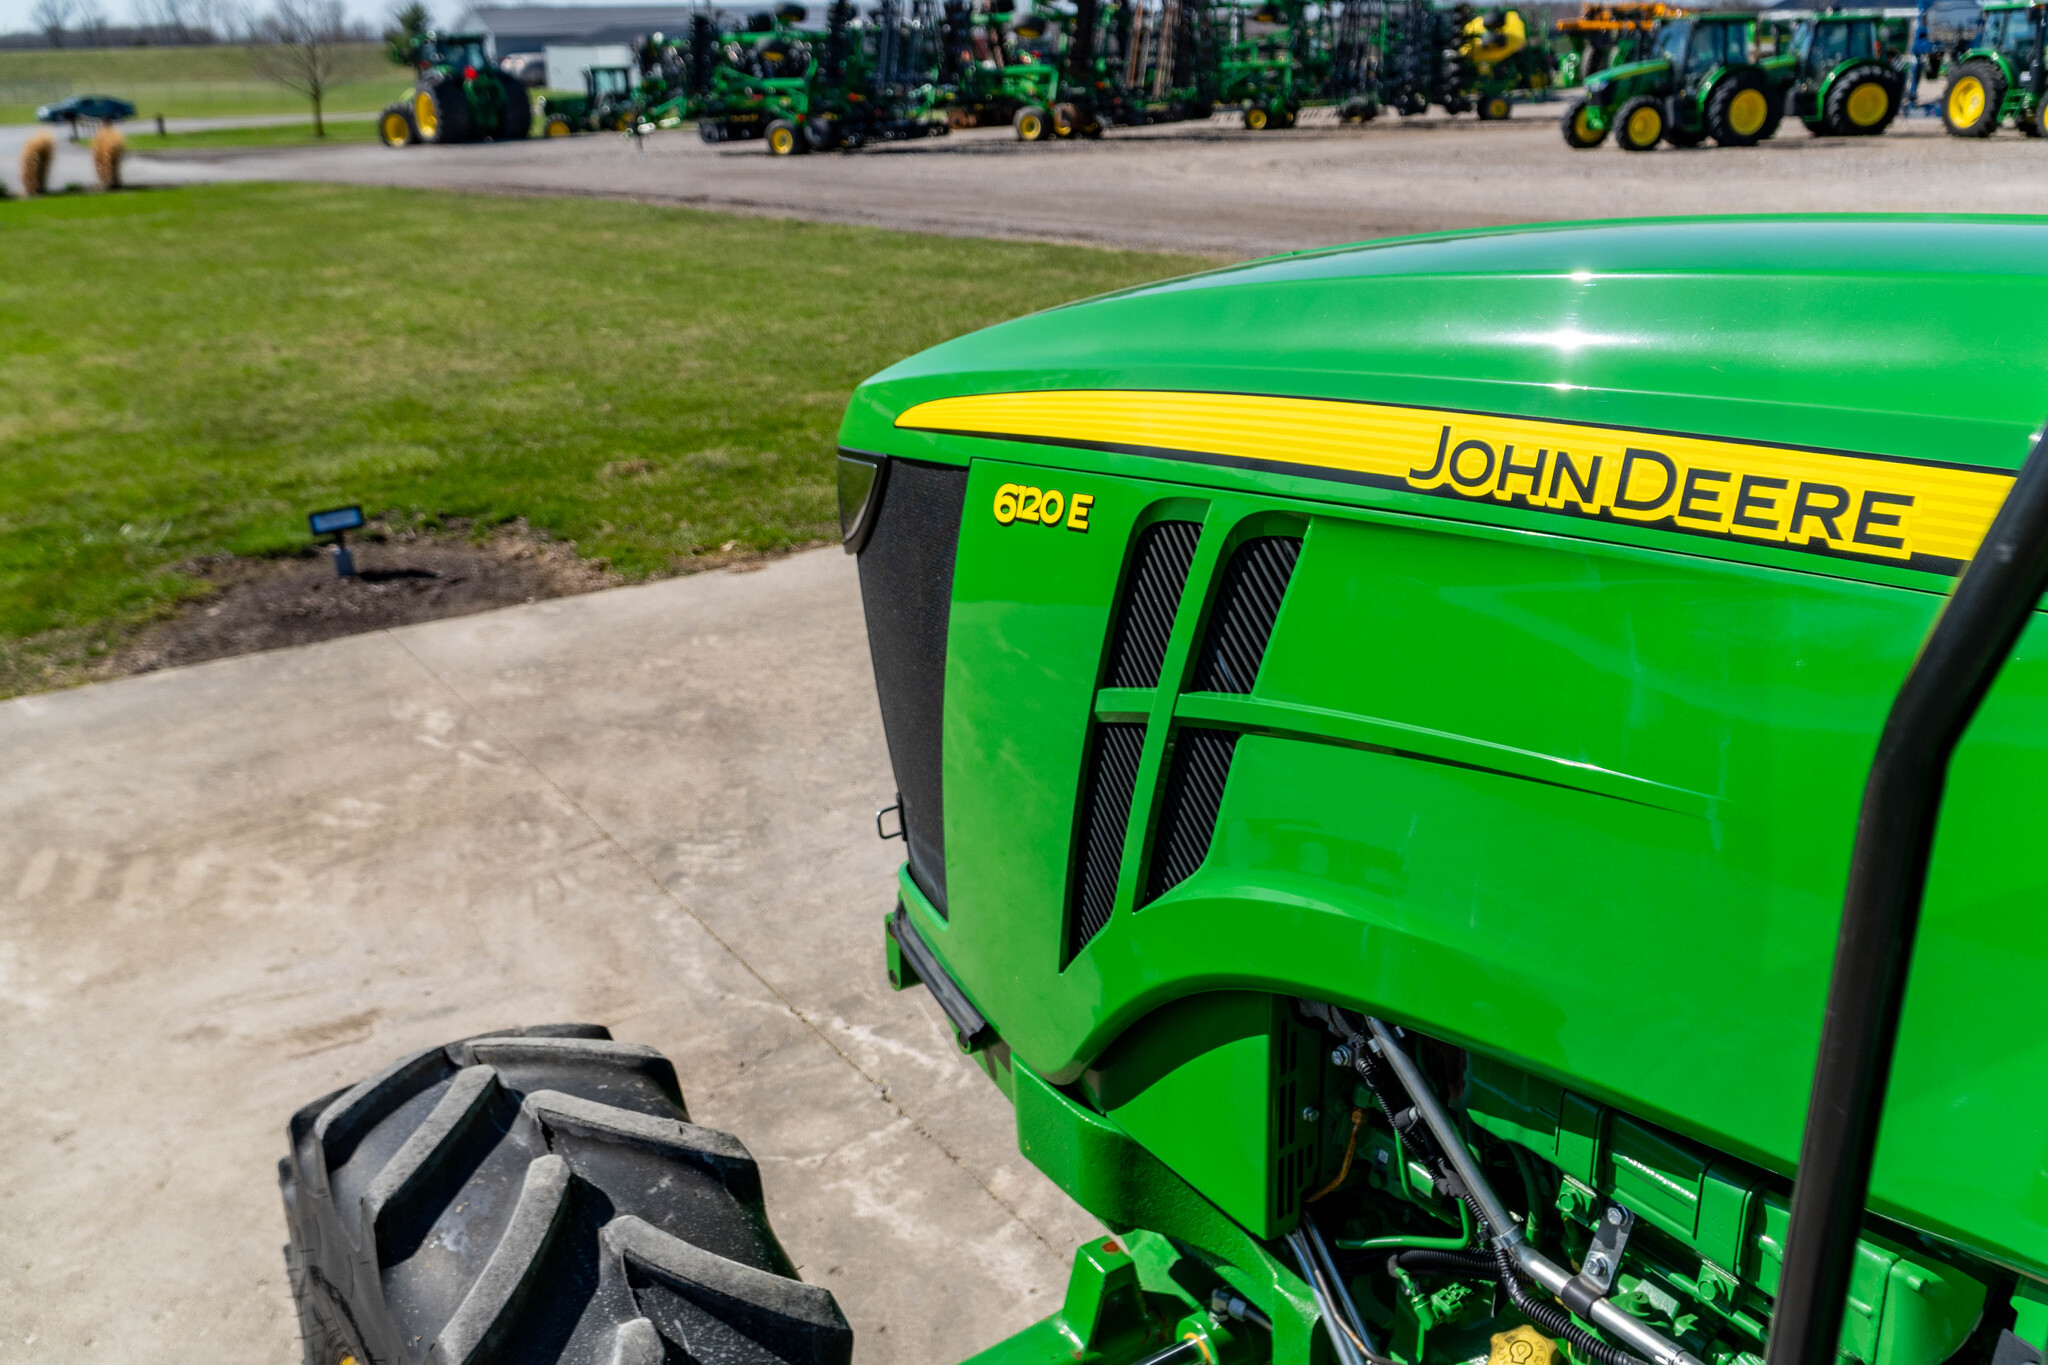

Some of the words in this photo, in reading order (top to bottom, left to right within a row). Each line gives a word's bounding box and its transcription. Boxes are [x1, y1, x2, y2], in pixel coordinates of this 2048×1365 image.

[993, 482, 1065, 528] 6120
[1066, 492, 1095, 534] E
[1407, 424, 1604, 506] JOHN
[1612, 446, 1917, 551] DEERE
